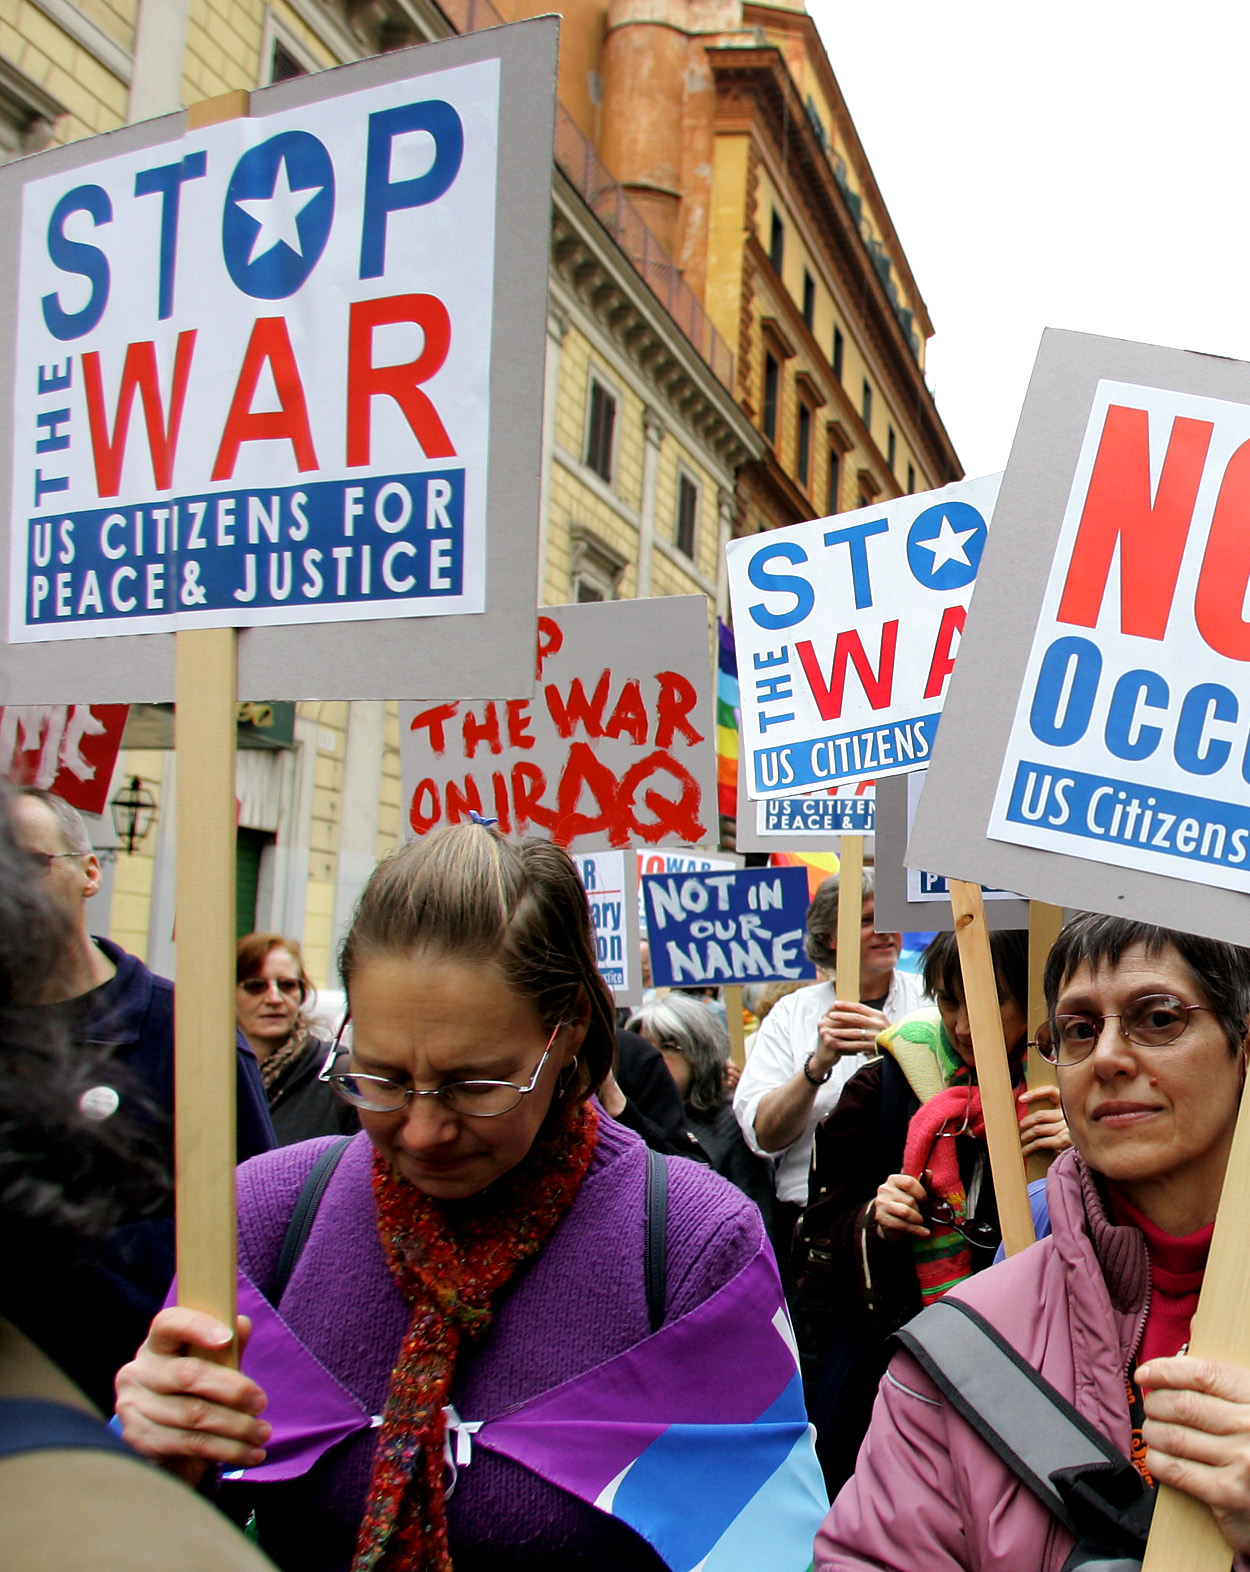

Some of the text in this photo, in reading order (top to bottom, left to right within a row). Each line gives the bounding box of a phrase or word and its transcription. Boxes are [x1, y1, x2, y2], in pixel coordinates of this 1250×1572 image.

[41, 99, 464, 341] STOP
[35, 355, 72, 508] THE
[81, 293, 457, 499] WAR
[33, 479, 453, 567] US CITIZENS FOR
[748, 502, 988, 630] STO
[33, 538, 453, 618] PEACE & JUSTICE
[753, 645, 795, 733] THE
[795, 605, 967, 721] WA
[410, 667, 705, 759] THE WAR
[761, 722, 929, 787] US CITIZENS
[409, 741, 707, 849] ON IRAQ
[769, 800, 875, 815] US CITIZEN
[769, 815, 832, 829] PEACE
[842, 815, 853, 829] &
[1020, 772, 1075, 825] US
[1086, 786, 1250, 864] Citizens
[648, 874, 736, 930] NOT
[747, 878, 783, 911] IN
[690, 913, 772, 941] OUR
[666, 928, 803, 982] NAME
